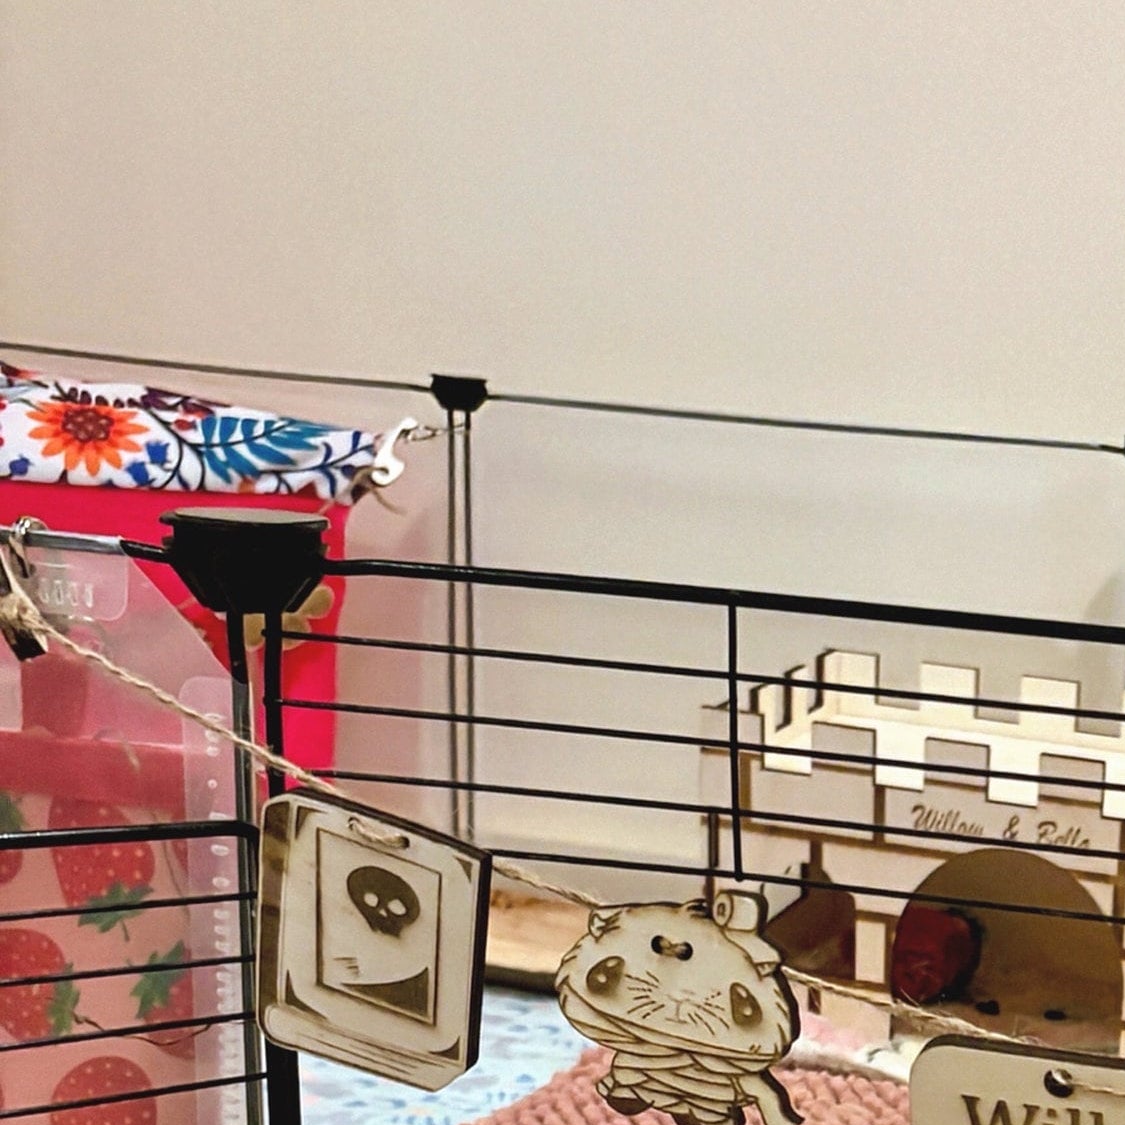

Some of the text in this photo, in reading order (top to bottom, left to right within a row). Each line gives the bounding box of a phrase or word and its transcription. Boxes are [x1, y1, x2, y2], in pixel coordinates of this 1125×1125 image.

[911, 803, 1091, 849] Willow & Bella
